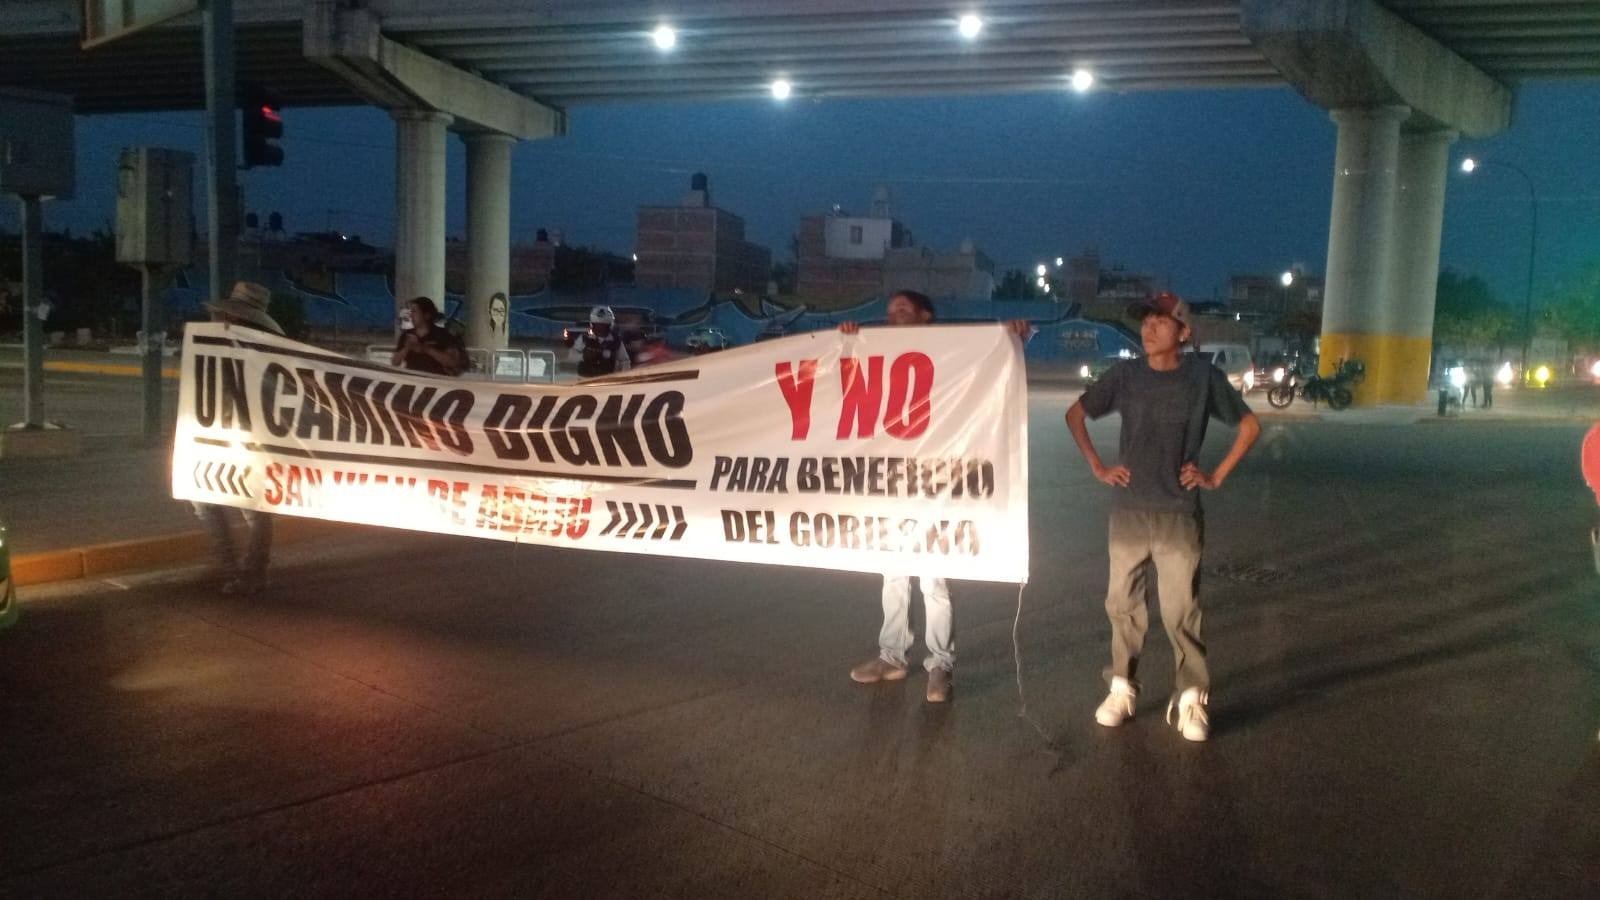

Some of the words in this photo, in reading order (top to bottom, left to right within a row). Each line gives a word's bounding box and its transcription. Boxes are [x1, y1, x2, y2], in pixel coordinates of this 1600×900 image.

[194, 355, 250, 430] UN
[260, 361, 474, 456] CAMINO
[484, 389, 693, 468] DIGNO
[775, 360, 817, 440] Y
[836, 352, 934, 440] NO
[265, 462, 323, 507] SAN
[709, 455, 789, 494] PARA
[797, 456, 994, 500] BENEFICIO
[721, 509, 779, 544] DEL
